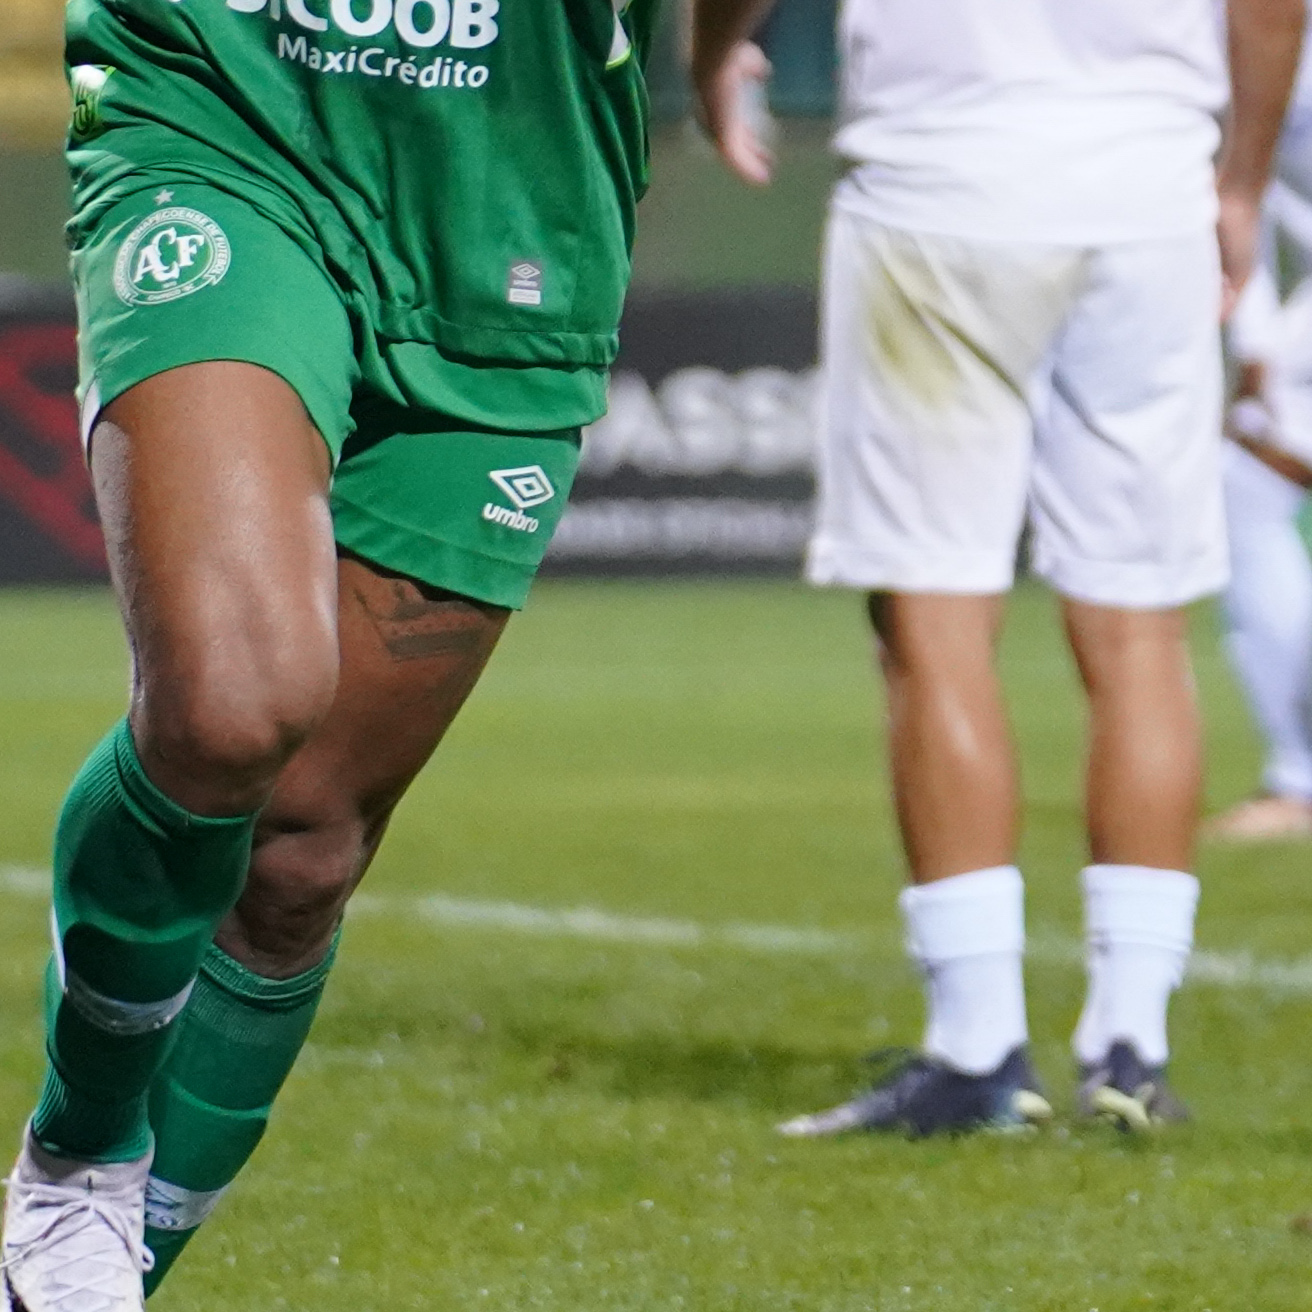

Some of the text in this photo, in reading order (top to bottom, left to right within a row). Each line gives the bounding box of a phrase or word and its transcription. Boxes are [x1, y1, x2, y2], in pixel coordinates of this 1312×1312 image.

[277, 32, 490, 88] MaxiCrédito
[133, 226, 205, 284] ACF
[482, 501, 539, 534] umbro
